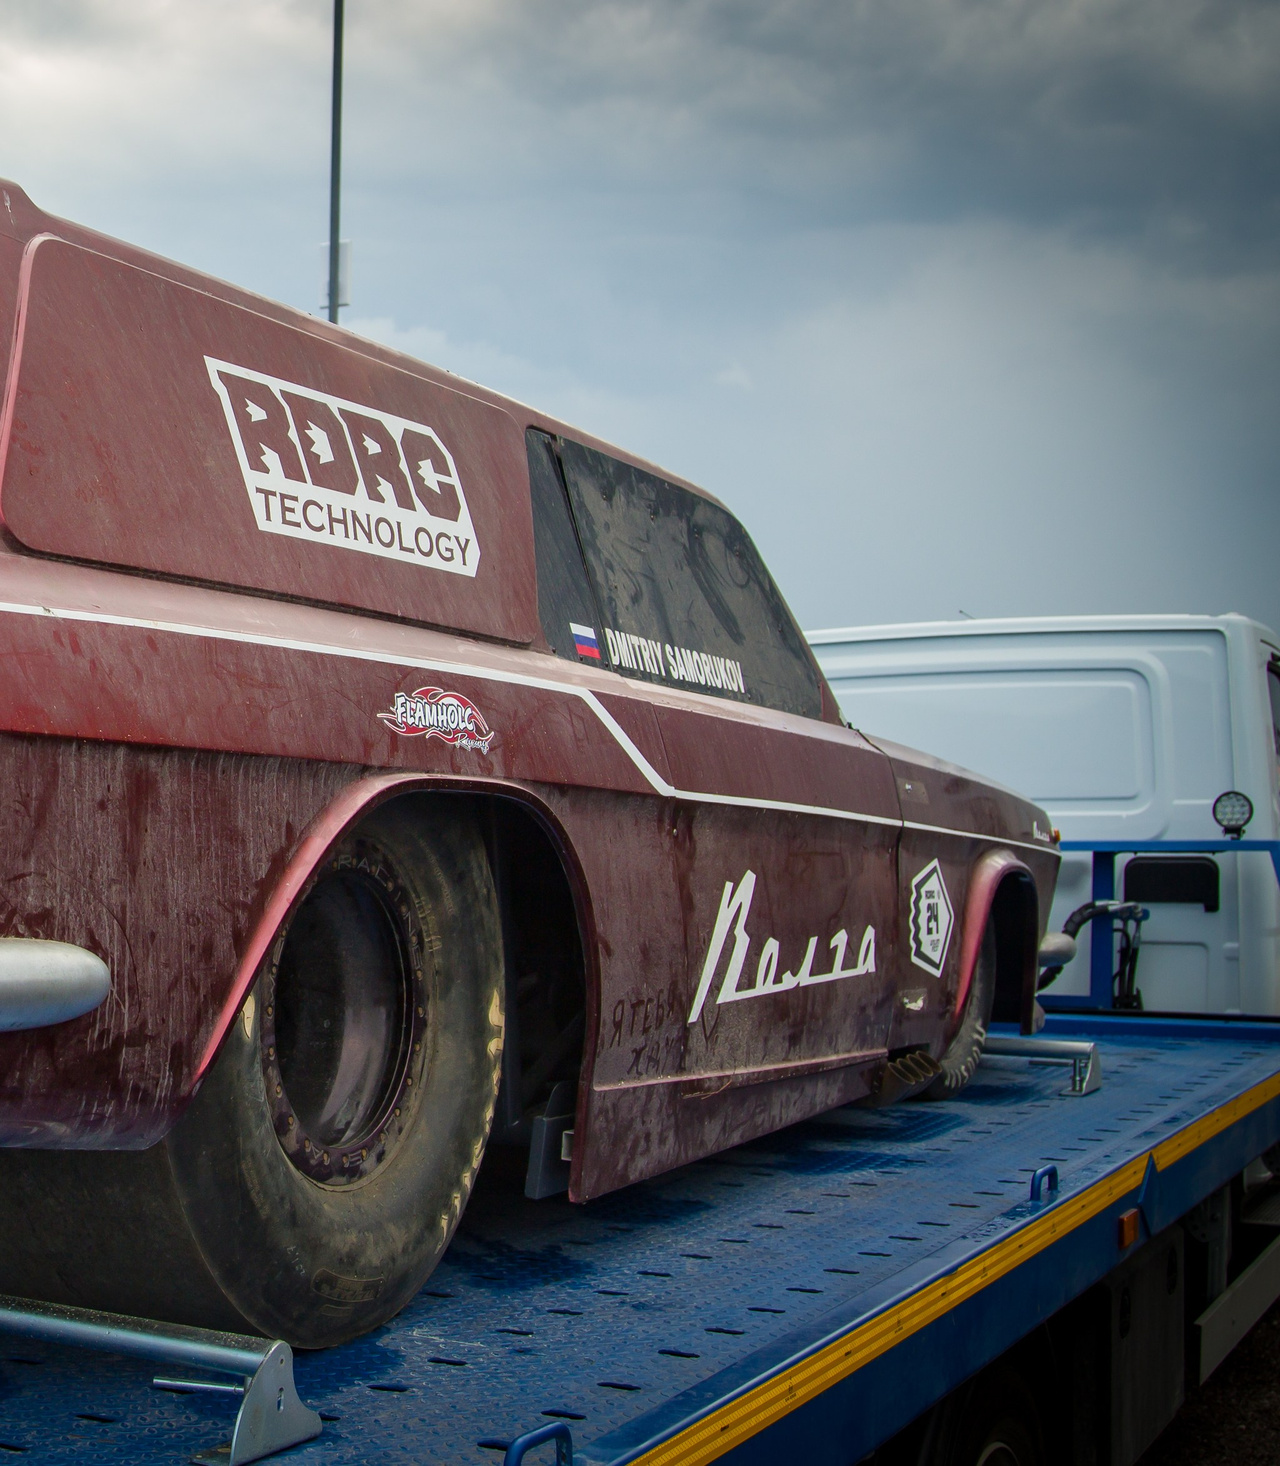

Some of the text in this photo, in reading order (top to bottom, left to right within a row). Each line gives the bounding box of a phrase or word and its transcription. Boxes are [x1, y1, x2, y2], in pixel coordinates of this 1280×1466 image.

[255, 485, 471, 566] TECHNOLOGY
[605, 627, 746, 694] DMITRIY SAMORUKOV
[926, 902, 939, 936] 24
